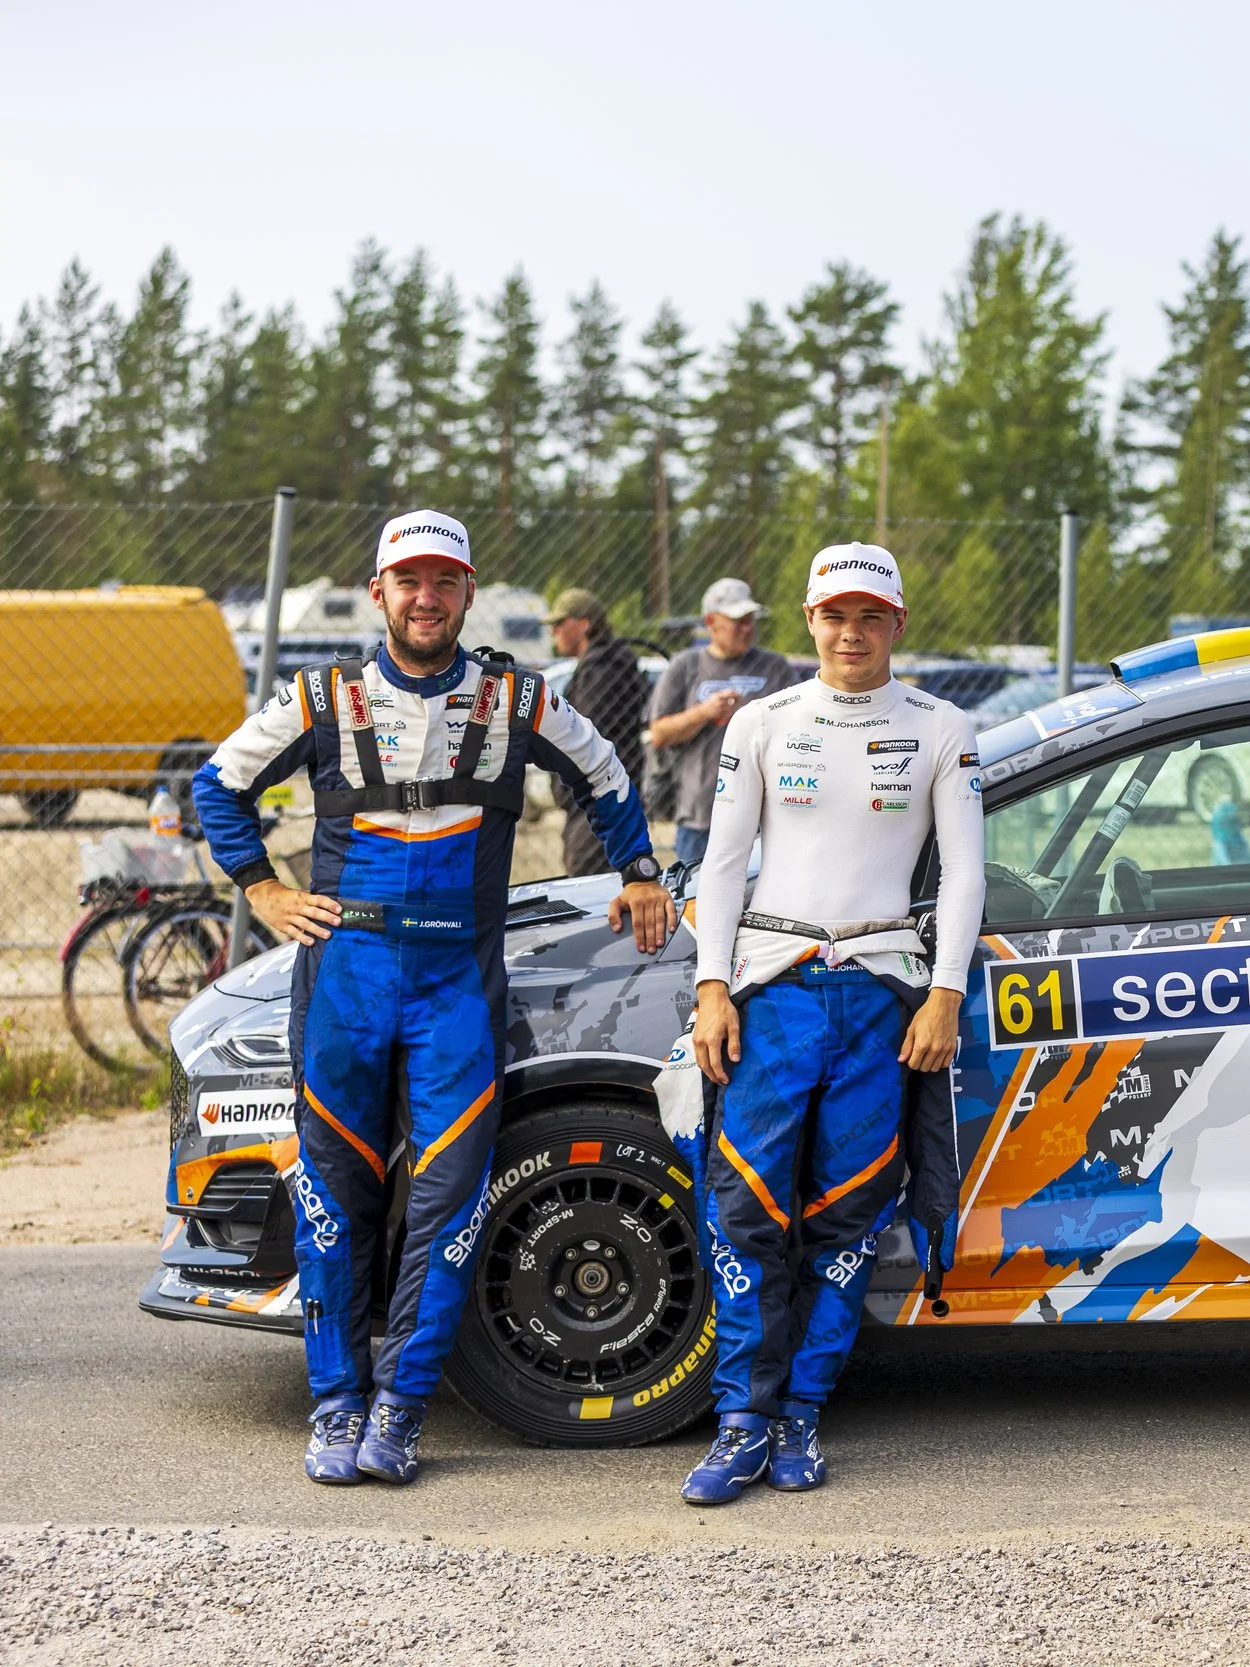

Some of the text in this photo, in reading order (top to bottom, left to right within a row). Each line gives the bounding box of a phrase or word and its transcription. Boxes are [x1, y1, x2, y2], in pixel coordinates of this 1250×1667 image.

[309, 670, 326, 712] sparco
[476, 679, 495, 720] SIMPSON
[517, 677, 535, 719] sparco
[832, 694, 872, 705] sparco
[349, 685, 366, 724] SIMPSON
[768, 694, 801, 711] sparco
[905, 696, 935, 711] sparco
[826, 718, 890, 729] M.JOHANSSON
[779, 775, 819, 789] MAK
[870, 782, 912, 792] haxman
[783, 796, 813, 805] MILLE
[998, 969, 1064, 1035] 61
[527, 1208, 575, 1247] M-SPORT
